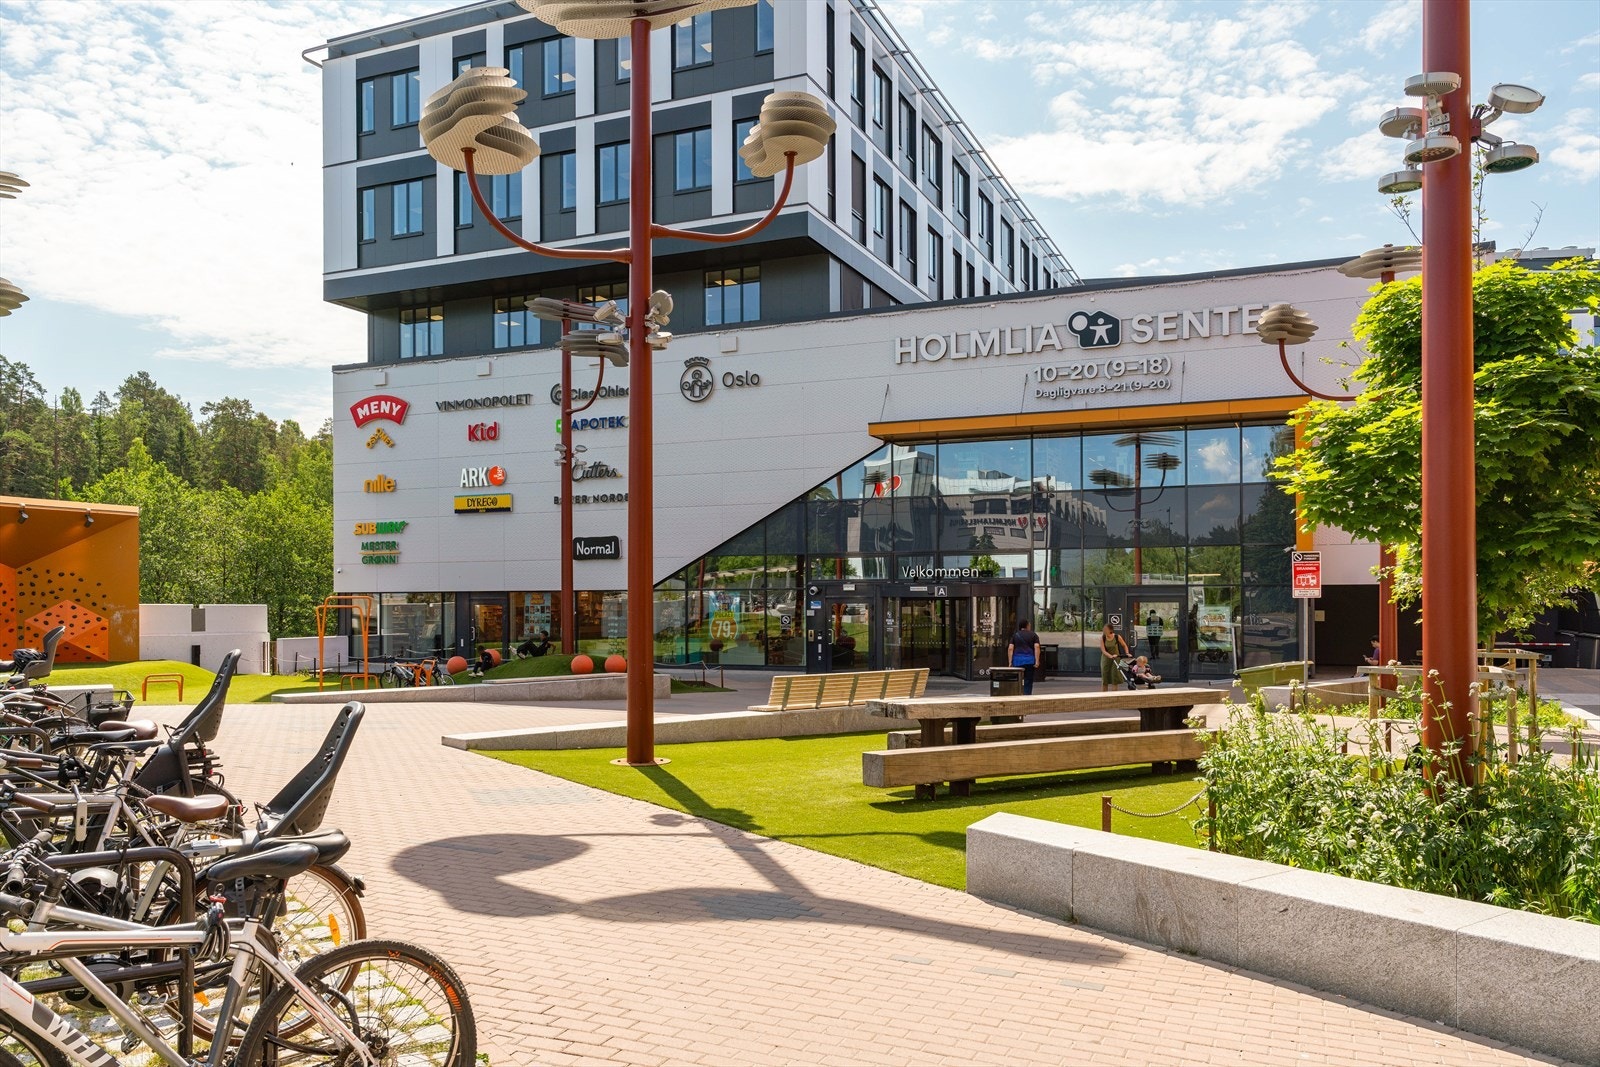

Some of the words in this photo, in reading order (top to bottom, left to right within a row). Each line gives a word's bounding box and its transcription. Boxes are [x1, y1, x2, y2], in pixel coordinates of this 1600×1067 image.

[894, 322, 1063, 364] HOLMLIA
[1130, 303, 1272, 344] SENTE
[1034, 361, 1098, 383] 10-20
[1104, 355, 1172, 380] (9-18)
[722, 370, 761, 388] Oslo
[598, 385, 630, 398] Ohls
[1035, 385, 1096, 400] Dagligvare
[1129, 377, 1172, 392] (9-20)
[356, 400, 402, 420] MENY
[435, 393, 532, 411] VINMONOPOLET
[468, 421, 499, 441] Kid
[571, 415, 626, 430] APOTEK
[460, 466, 489, 488] ARK
[572, 460, 617, 482] Cutters
[363, 473, 396, 493] nille
[466, 497, 498, 507] DYREGO
[553, 494, 588, 505] BER
[592, 492, 629, 503] NORD
[353, 520, 409, 536] SUBWAY
[361, 541, 398, 552] MESTER
[576, 540, 615, 556] Normal
[902, 565, 979, 578] Velkommen
[938, 587, 946, 596] A
[46, 1012, 122, 1067] WHI
